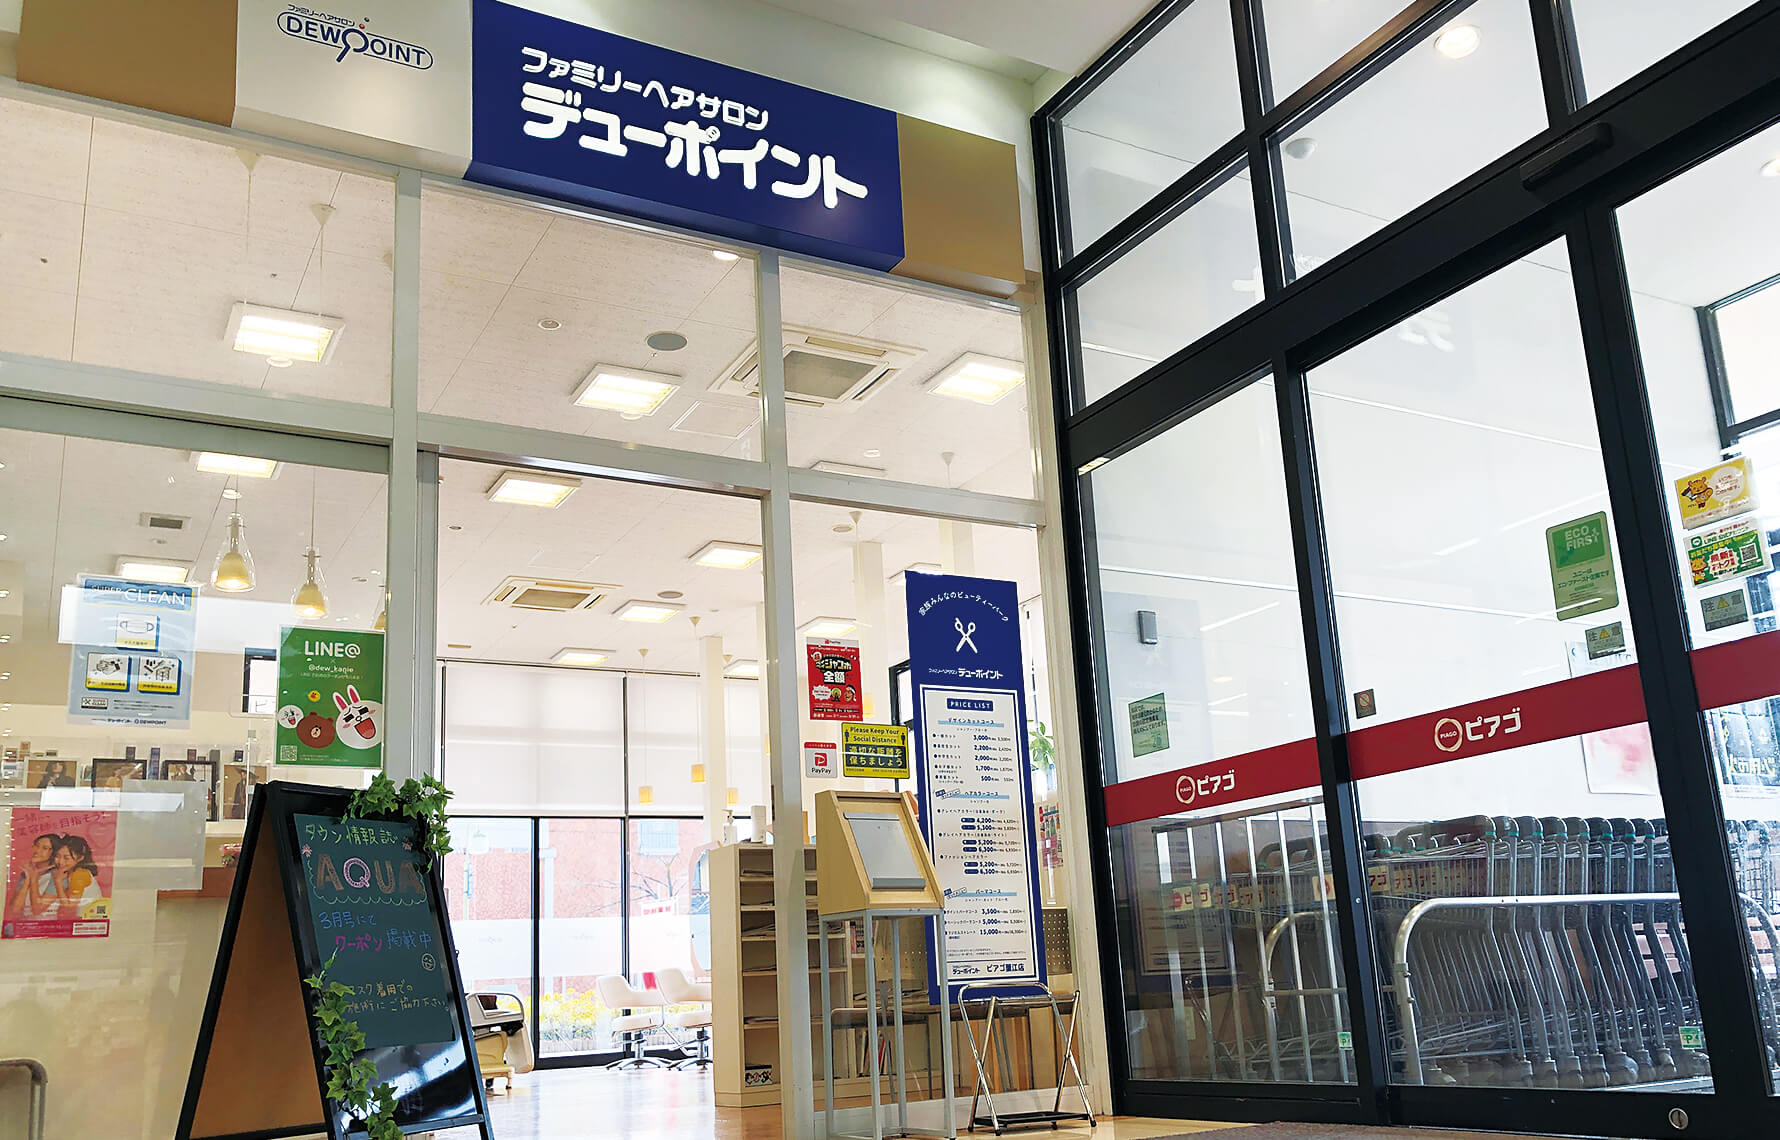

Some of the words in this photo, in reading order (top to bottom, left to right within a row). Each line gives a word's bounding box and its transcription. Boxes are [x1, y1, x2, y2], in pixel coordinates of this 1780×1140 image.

[288, 4, 355, 27] ファミリーヘアサロン
[286, 16, 426, 65] DEWPOINT
[522, 47, 768, 130] ファミリーヘアサロン
[521, 82, 868, 208] デューポイント
[1564, 525, 1589, 541] ECO
[124, 588, 185, 606] CLEAN
[304, 640, 361, 659] LINE@
[958, 667, 1004, 680] デューポイント
[950, 701, 971, 709] PRICE
[974, 702, 990, 710] LIST
[1465, 707, 1523, 742] ピアゴ
[872, 736, 896, 744] Distance
[811, 767, 831, 775] PayPay
[850, 757, 903, 766] 保ちましょう
[1197, 769, 1236, 796] ピアゴ
[316, 854, 424, 895] AQUA
[319, 911, 377, 930] 3月号にて
[336, 934, 383, 952] クーポン
